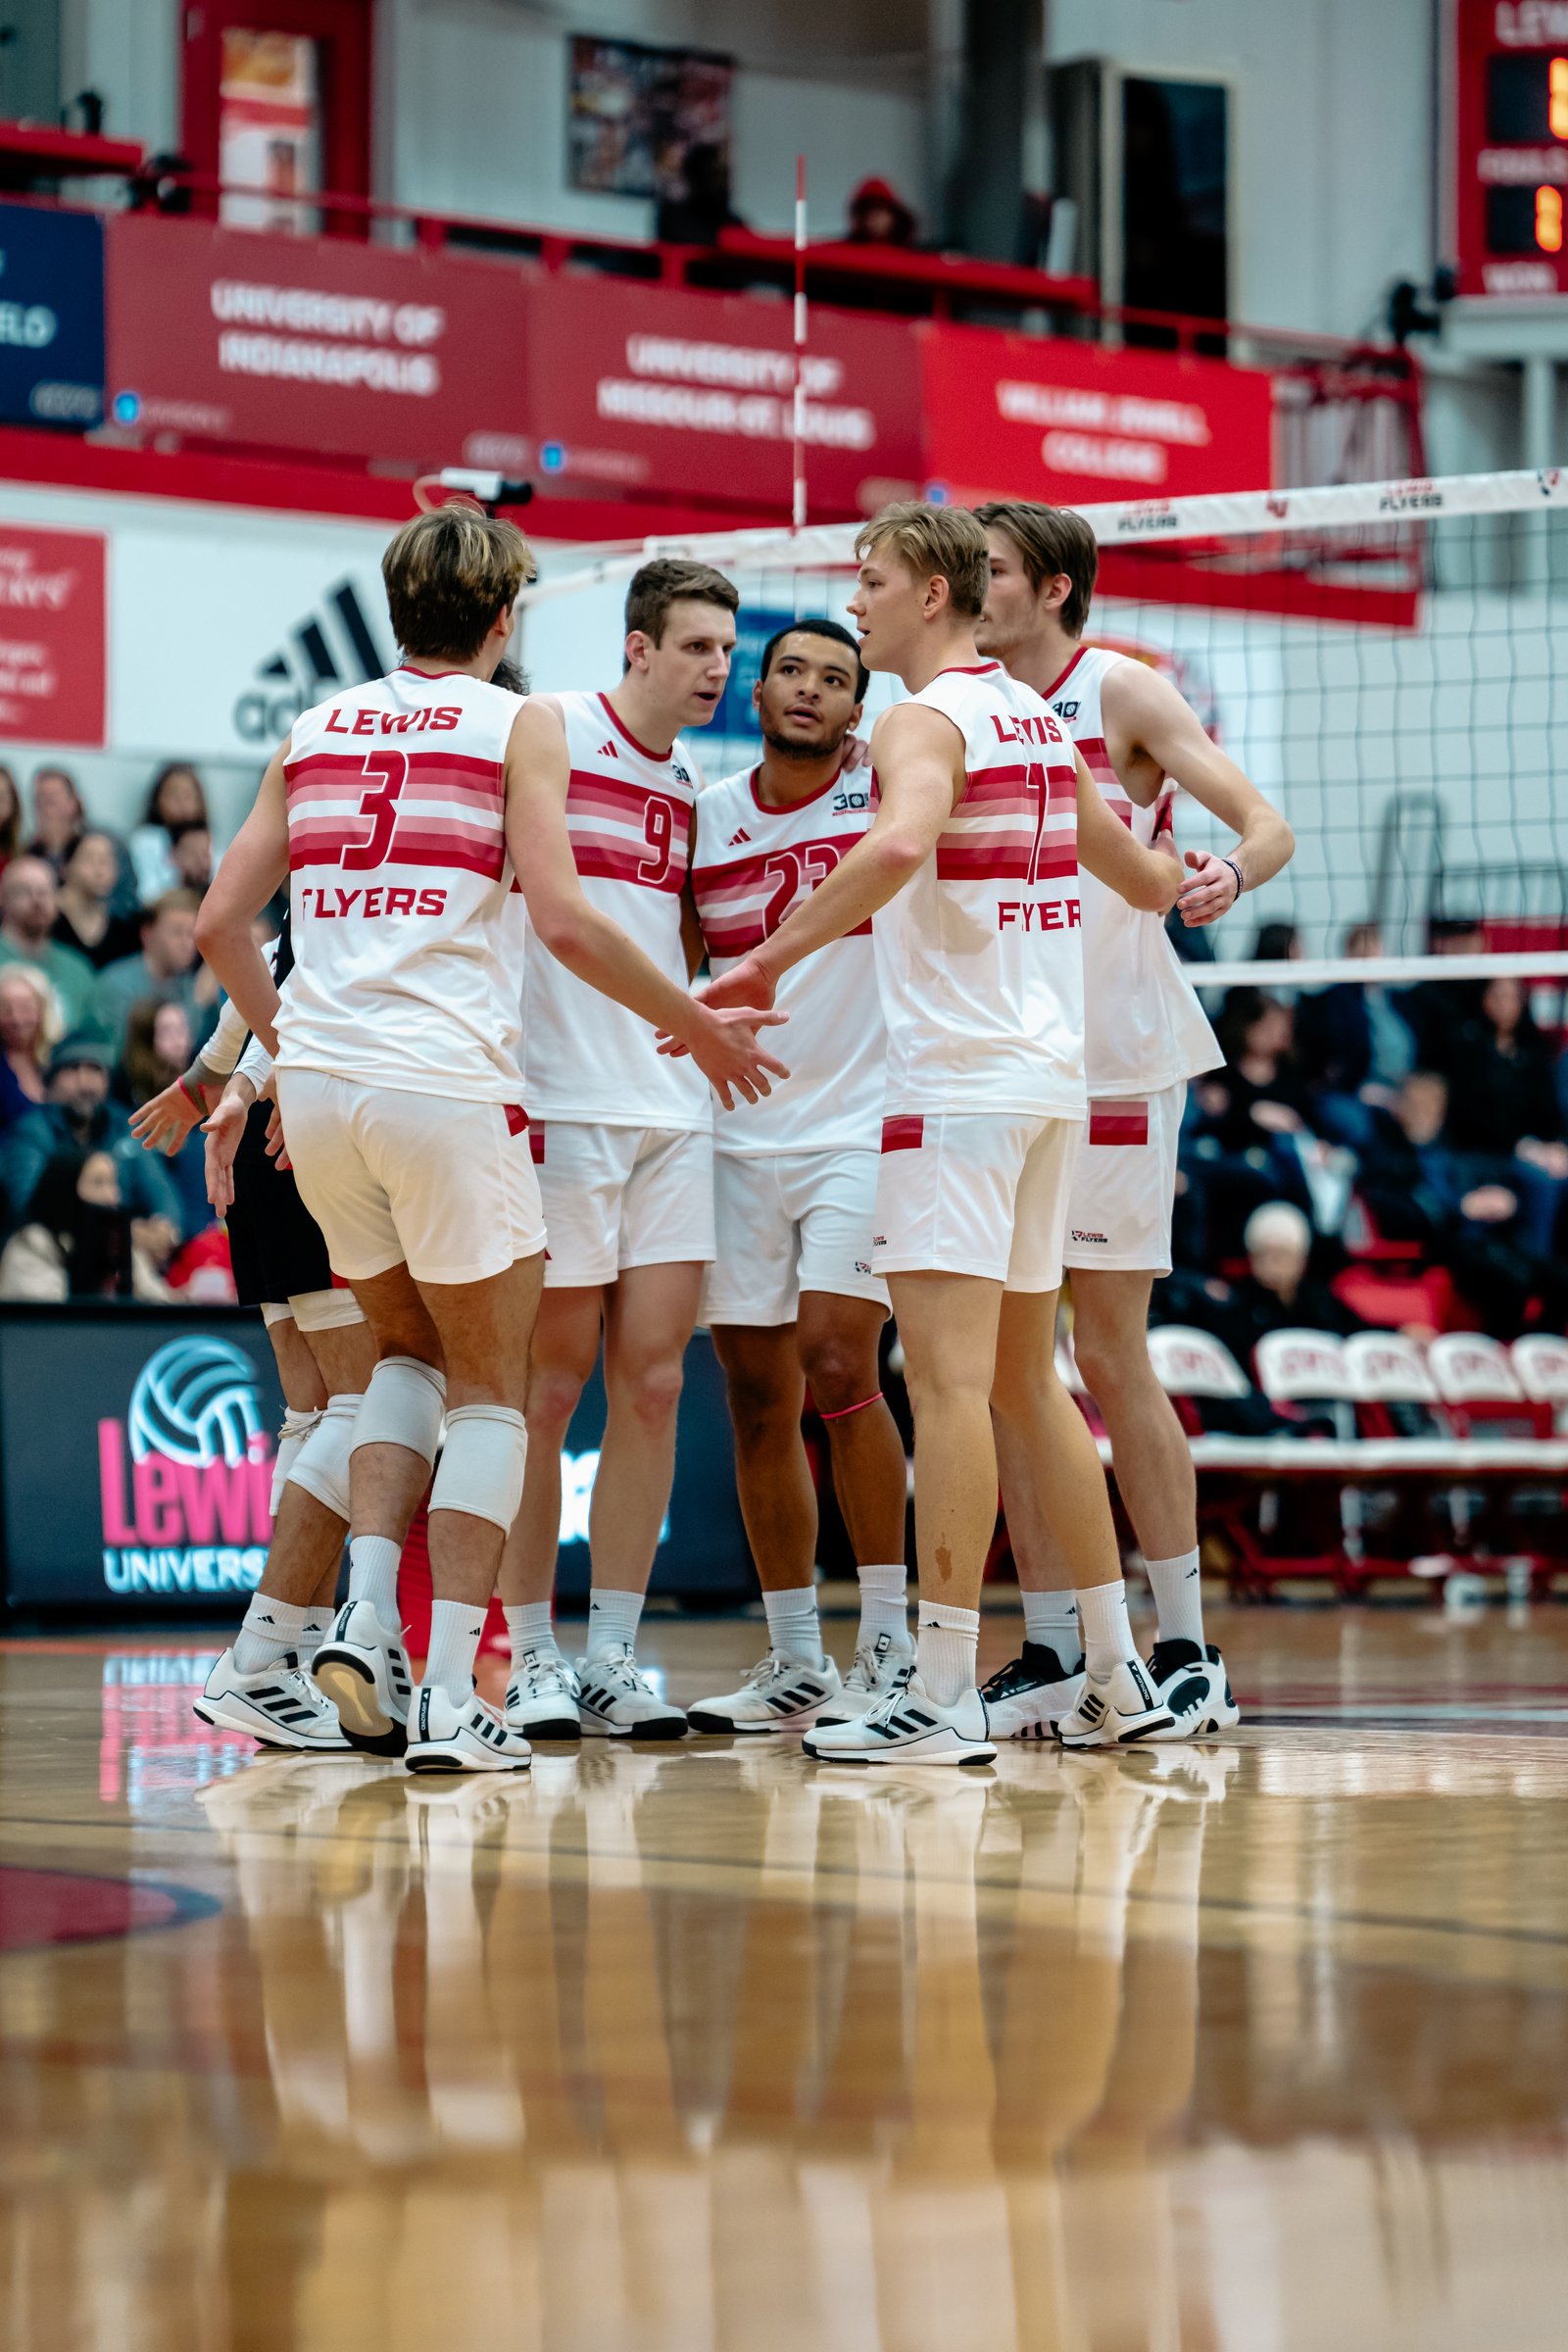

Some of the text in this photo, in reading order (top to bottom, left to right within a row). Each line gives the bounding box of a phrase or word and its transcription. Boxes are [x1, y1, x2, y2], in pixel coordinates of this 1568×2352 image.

[211, 278, 444, 345] UNIVERSITY OF
[219, 331, 438, 397] INDIANAPOLIS
[627, 333, 794, 389] UNIVERSITY
[323, 707, 464, 736] LEWIS
[341, 749, 409, 871] 3
[638, 795, 672, 884] 9
[998, 899, 1082, 932] FYER
[99, 1418, 277, 1545] Lewi
[103, 1545, 269, 1594] UNIVERS
